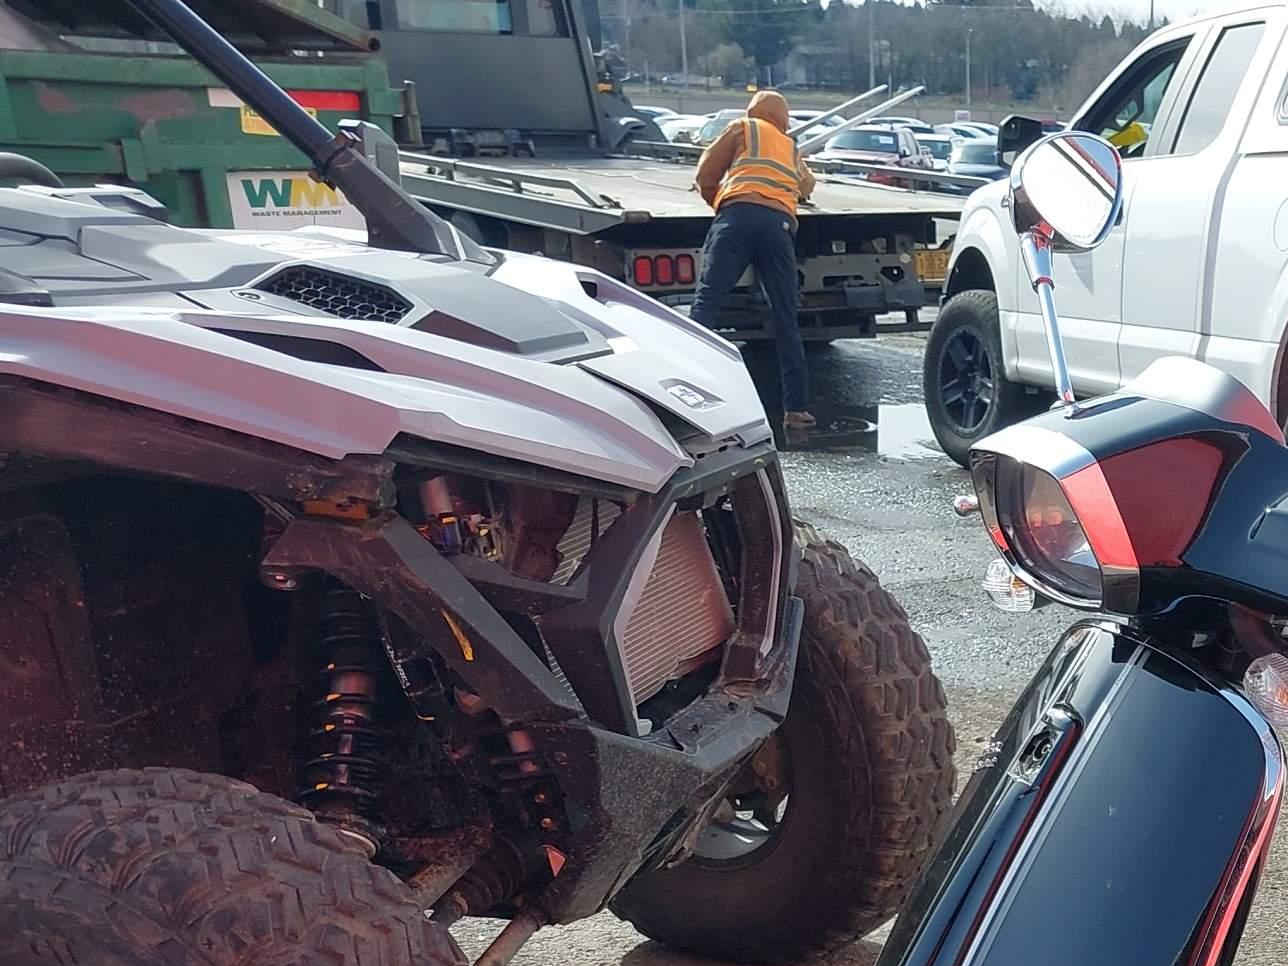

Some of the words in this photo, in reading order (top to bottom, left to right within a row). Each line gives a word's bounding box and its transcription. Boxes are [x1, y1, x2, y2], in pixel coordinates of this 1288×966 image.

[240, 177, 341, 209] WM
[251, 210, 281, 218] WASTE
[283, 209, 342, 217] MANAGEMENT
